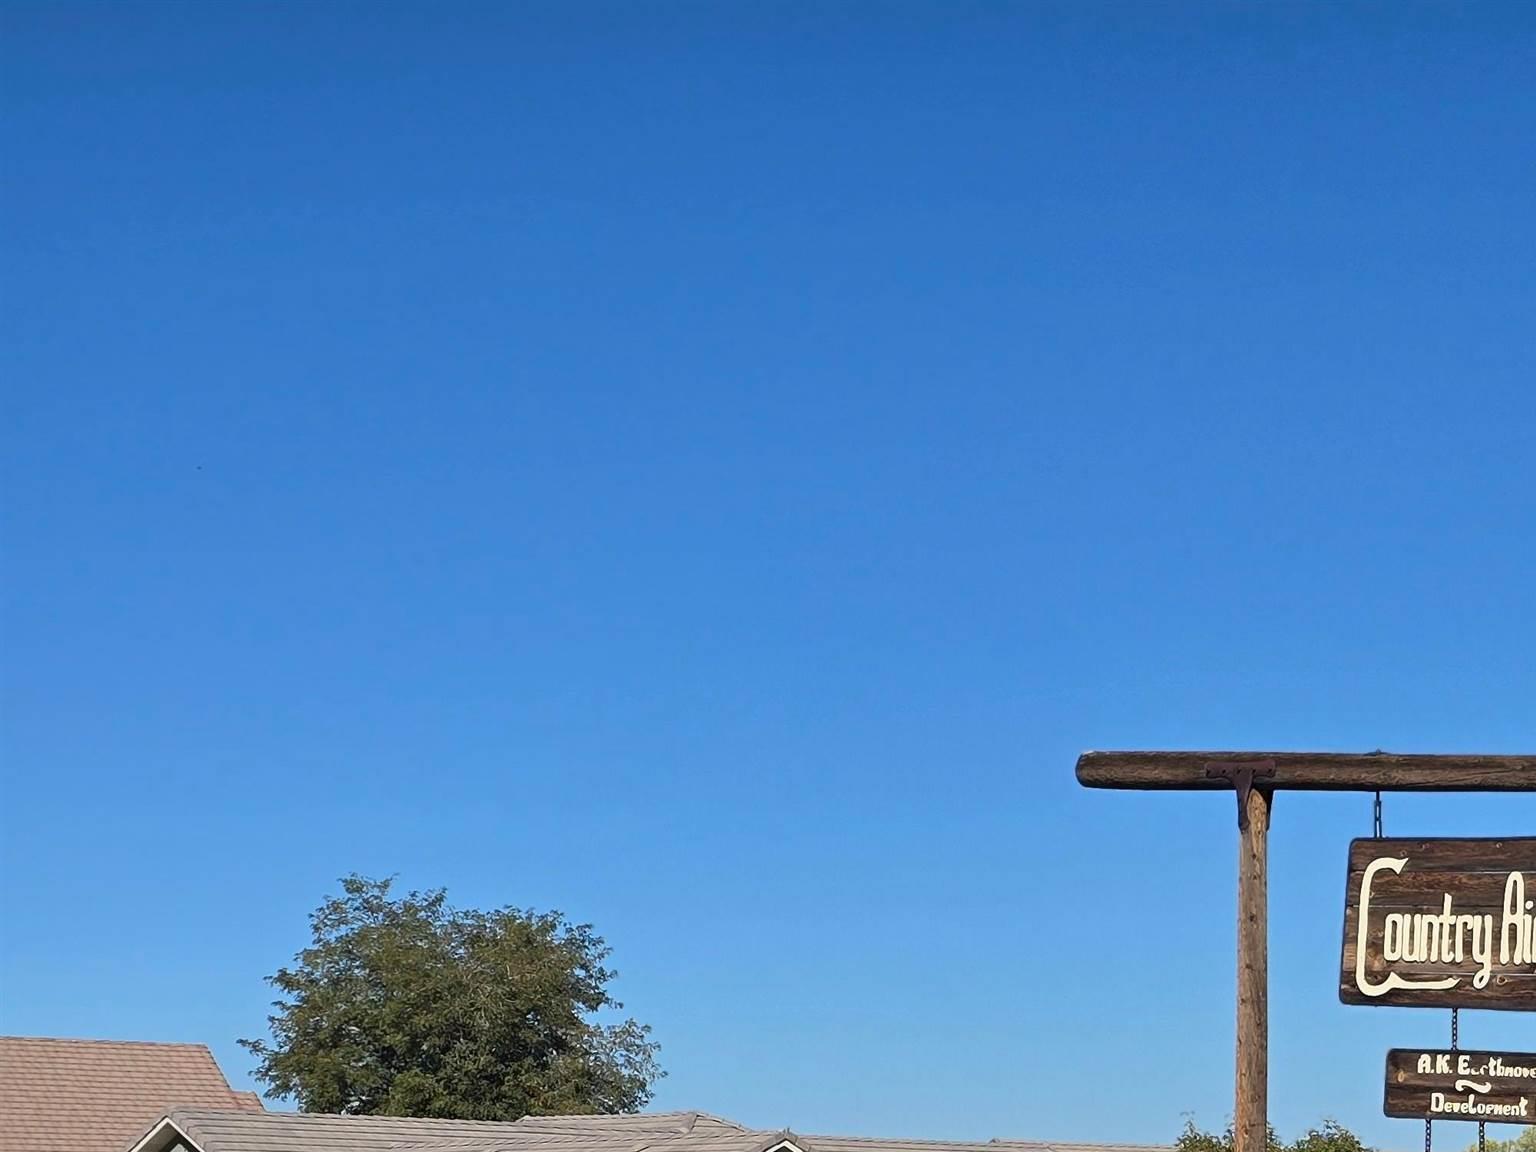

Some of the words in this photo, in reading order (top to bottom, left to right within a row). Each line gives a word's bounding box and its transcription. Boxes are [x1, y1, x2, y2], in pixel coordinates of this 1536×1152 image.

[1355, 856, 1493, 997] Country
[1417, 1053, 1453, 1074] A.K.
[1430, 1092, 1529, 1117] Development
